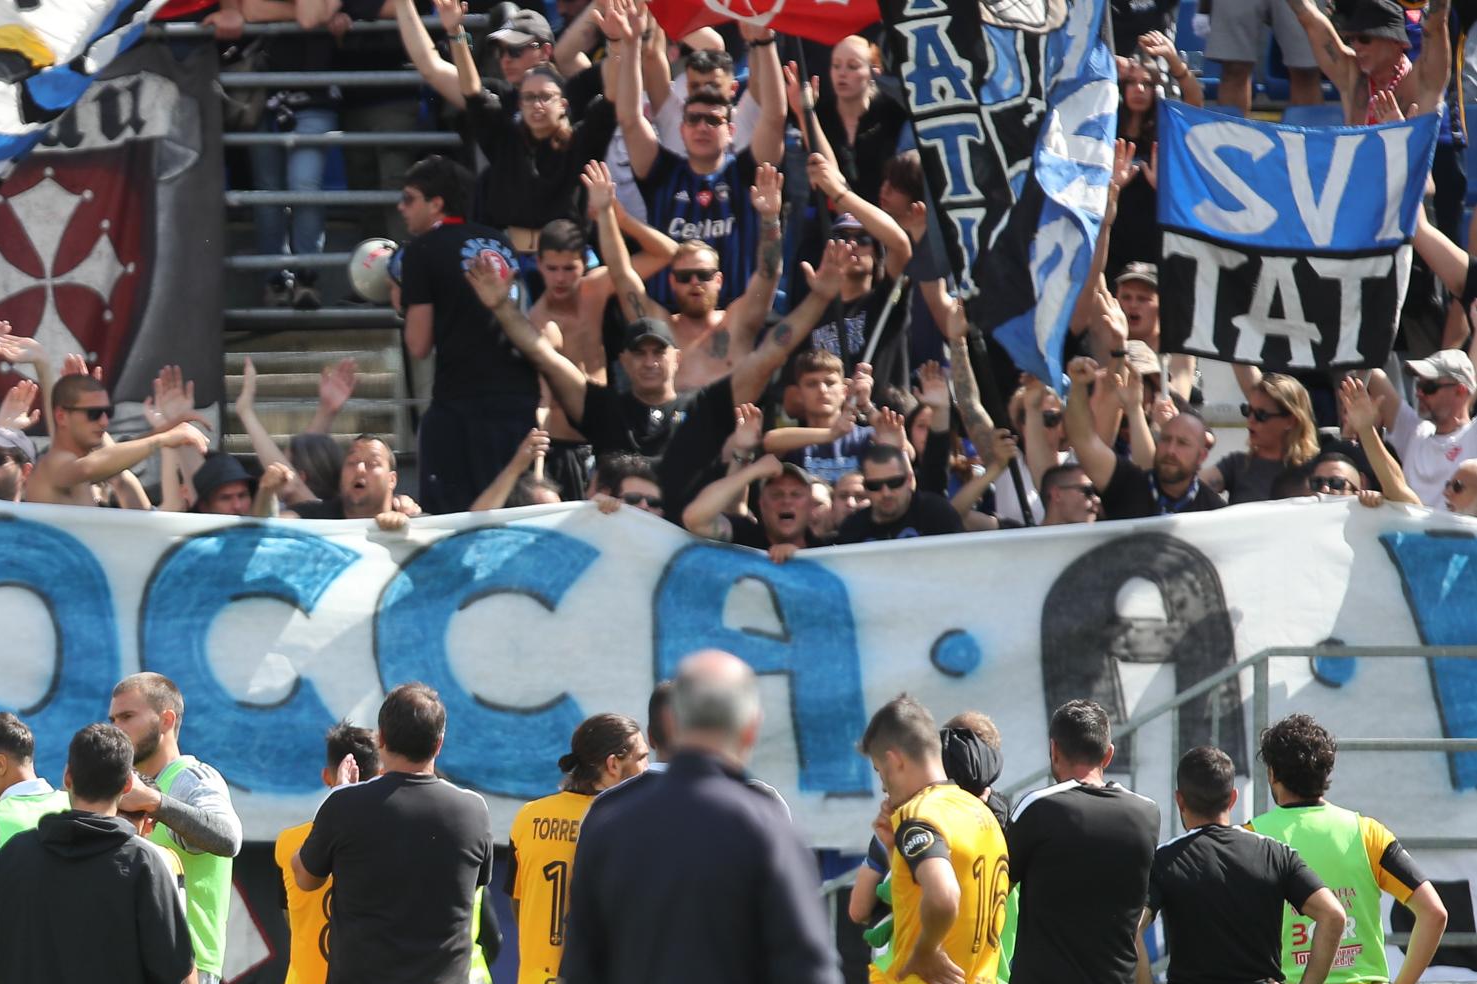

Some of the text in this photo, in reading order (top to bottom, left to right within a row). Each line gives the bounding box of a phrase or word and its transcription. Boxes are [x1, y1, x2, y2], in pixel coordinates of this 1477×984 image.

[1185, 121, 1414, 248] SVI
[532, 817, 580, 843] TORRE
[972, 854, 1010, 954] 16
